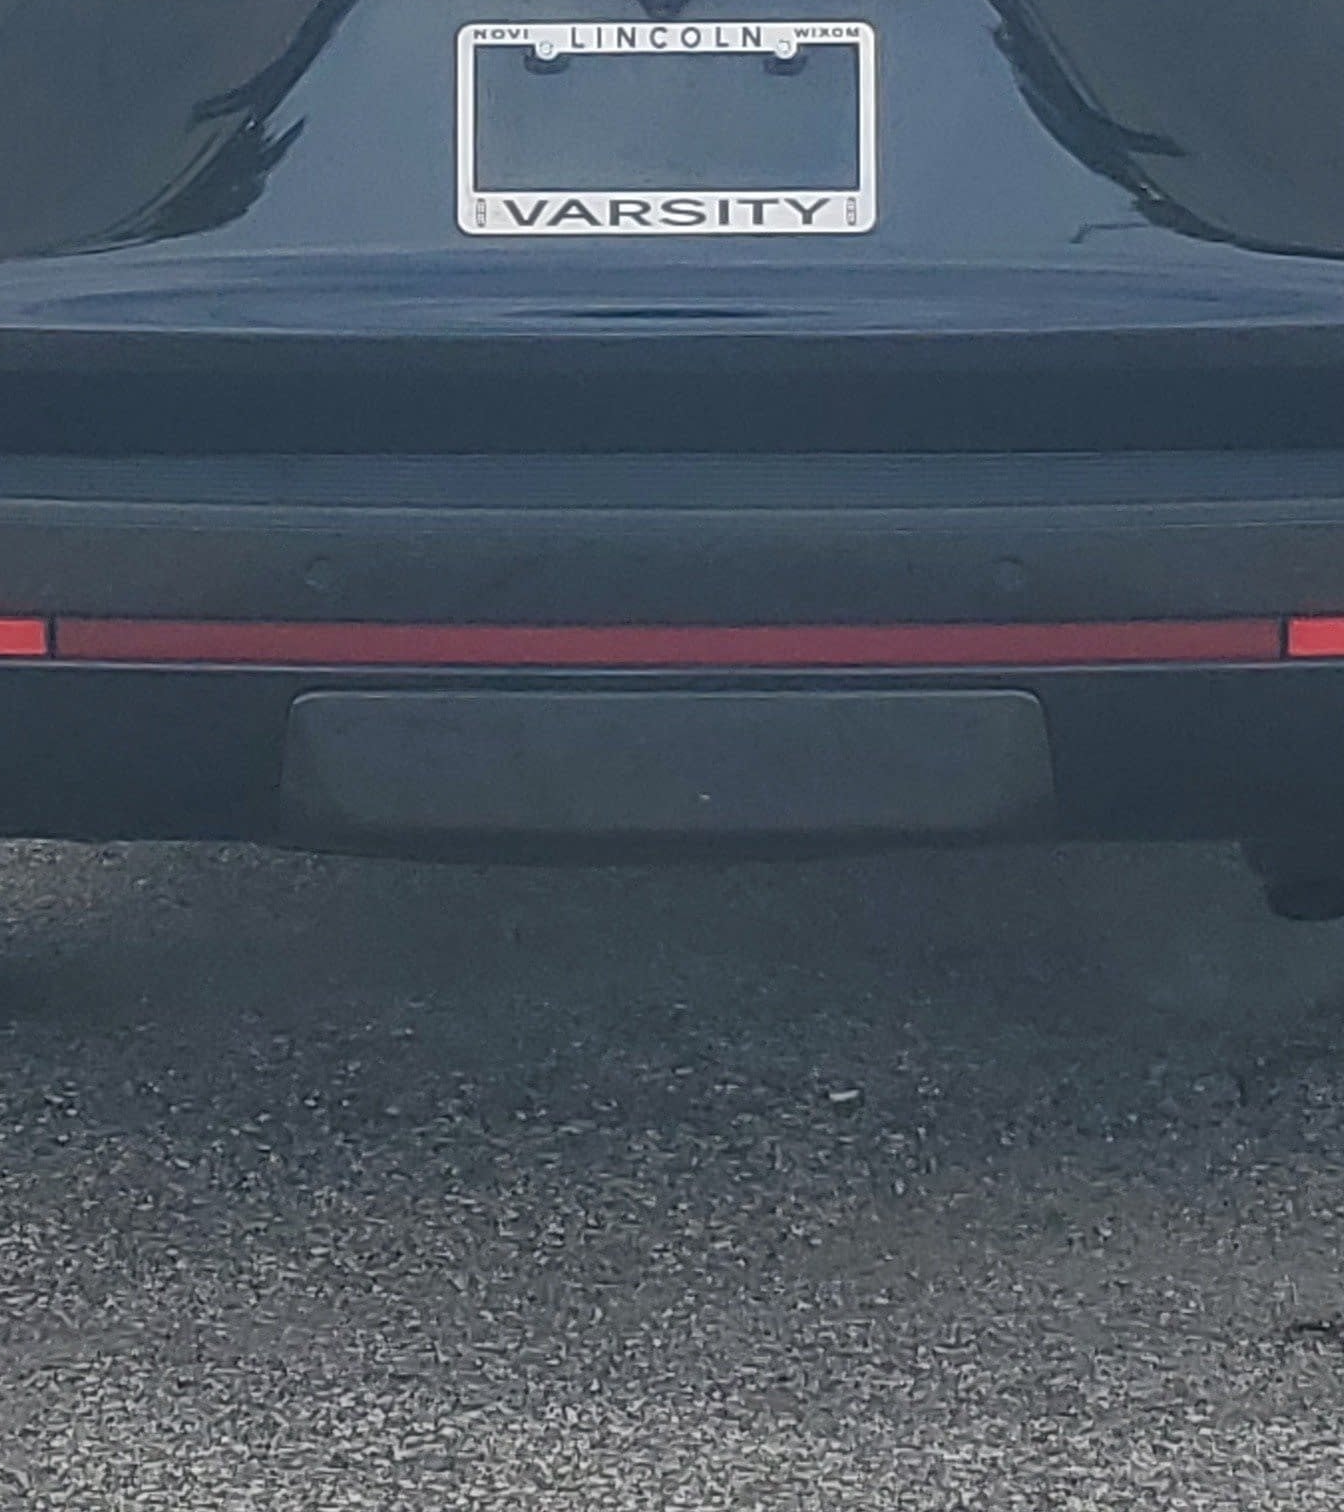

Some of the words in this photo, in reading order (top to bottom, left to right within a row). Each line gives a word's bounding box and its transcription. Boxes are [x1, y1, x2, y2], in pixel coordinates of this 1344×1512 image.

[473, 28, 529, 40] NOVI
[571, 26, 762, 49] LINCOLN
[795, 26, 860, 38] WIXOM
[503, 199, 831, 227] VARSITY
